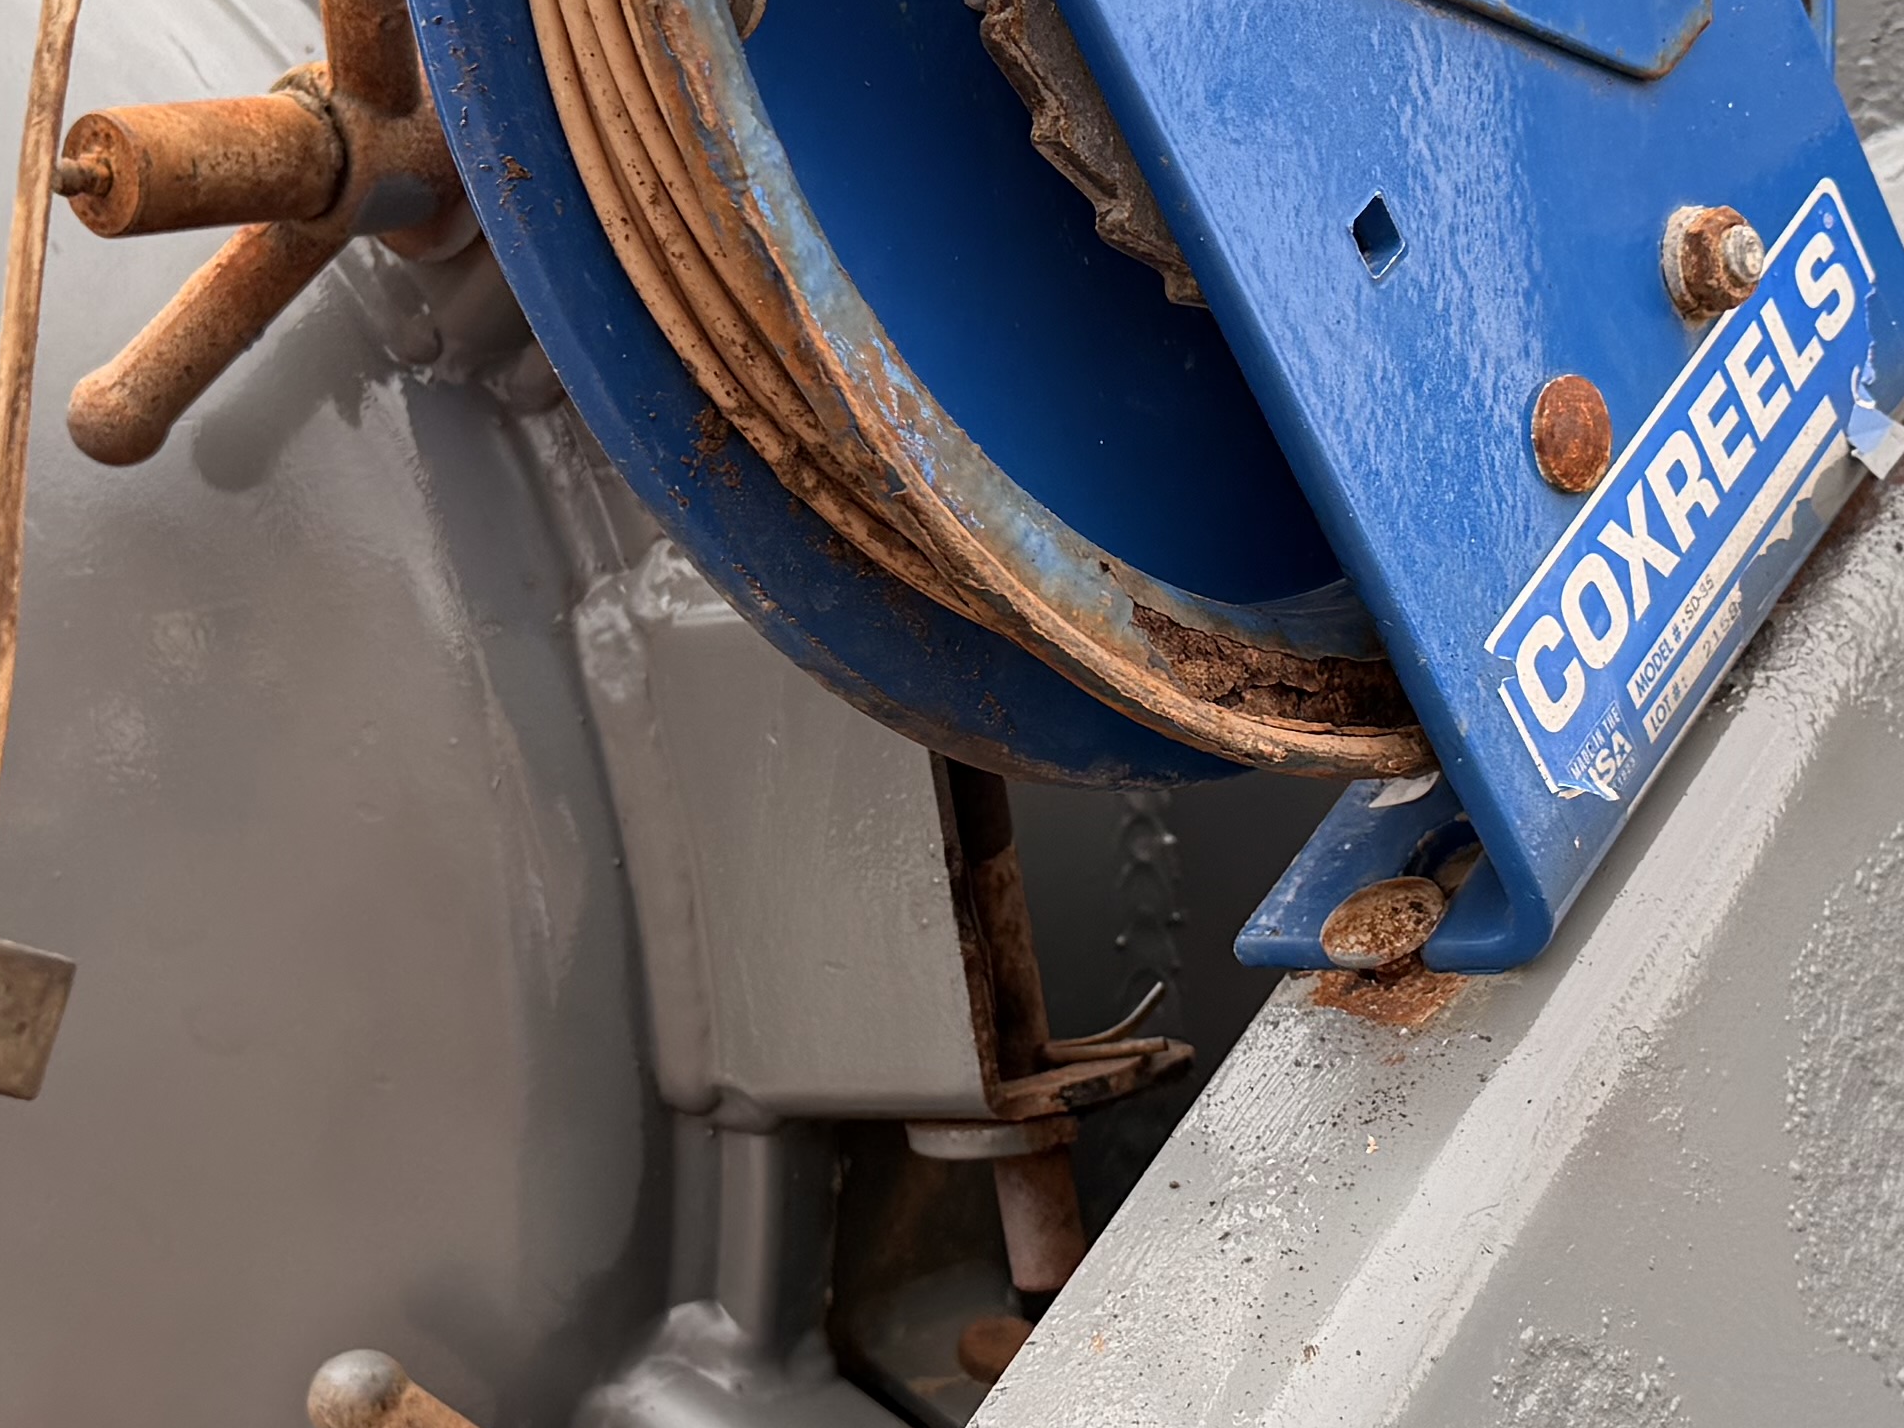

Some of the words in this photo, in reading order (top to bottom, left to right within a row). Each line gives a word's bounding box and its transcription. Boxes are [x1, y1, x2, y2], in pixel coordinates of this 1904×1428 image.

[1516, 231, 1856, 733] COXREELS
[1633, 638, 1675, 699] MODEL
[1602, 704, 1622, 734] THE
[1649, 697, 1674, 733] LOT
